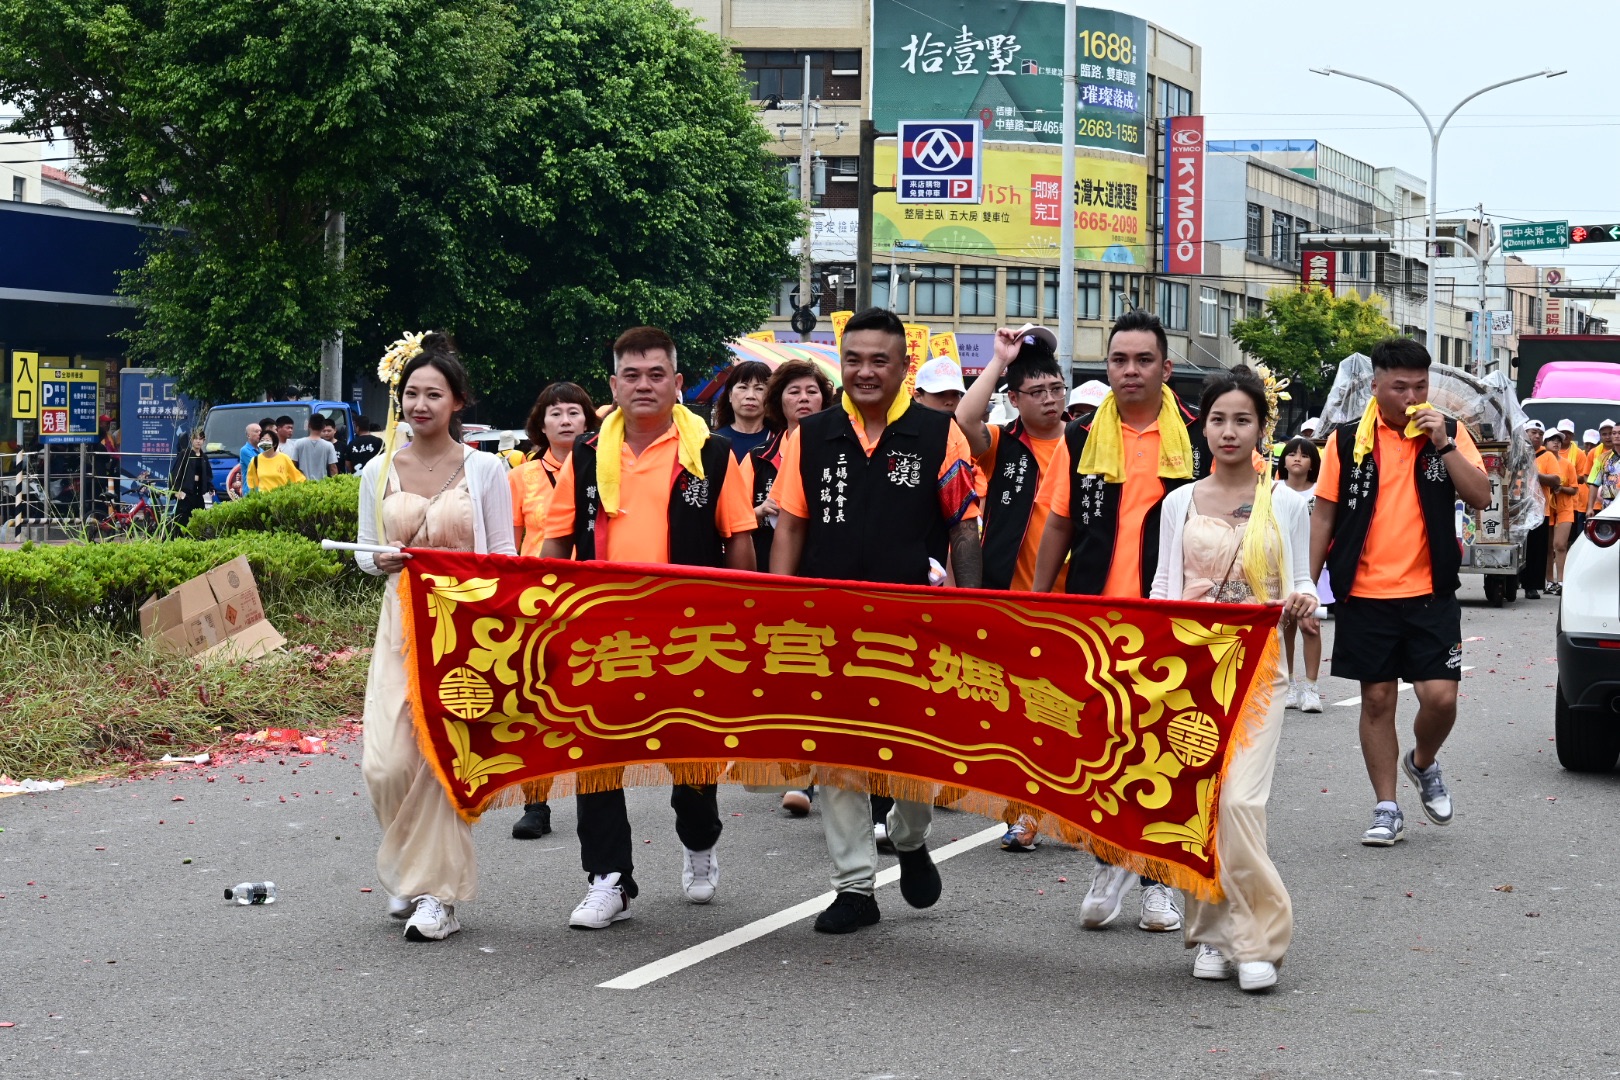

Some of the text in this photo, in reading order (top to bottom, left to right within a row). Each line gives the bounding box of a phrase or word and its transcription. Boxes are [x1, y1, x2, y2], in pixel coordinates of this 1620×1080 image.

[900, 25, 1022, 76] 拾壹墅
[1079, 30, 1132, 64] 1688
[1082, 85, 1134, 110] 璀璨落成
[1078, 118, 1138, 143] 2663-1555
[953, 181, 968, 196] P
[1034, 181, 1059, 200] 即將
[904, 208, 1010, 223] 整層主臥 五大房 雙車位
[1034, 203, 1059, 220] 完工
[1176, 157, 1195, 262] KYMCO
[1508, 239, 1535, 247] Zhongyang
[1536, 237, 1545, 245] Rd.
[1546, 236, 1557, 244] Sec.
[1513, 224, 1566, 238] 中央路一段
[17, 358, 33, 412] 入口
[43, 383, 54, 405] P
[43, 411, 66, 432] 免費
[821, 467, 832, 523] 馬瑞昌
[835, 453, 848, 523] 三媽會會長
[567, 618, 1086, 738] 浩天宮三媽會
